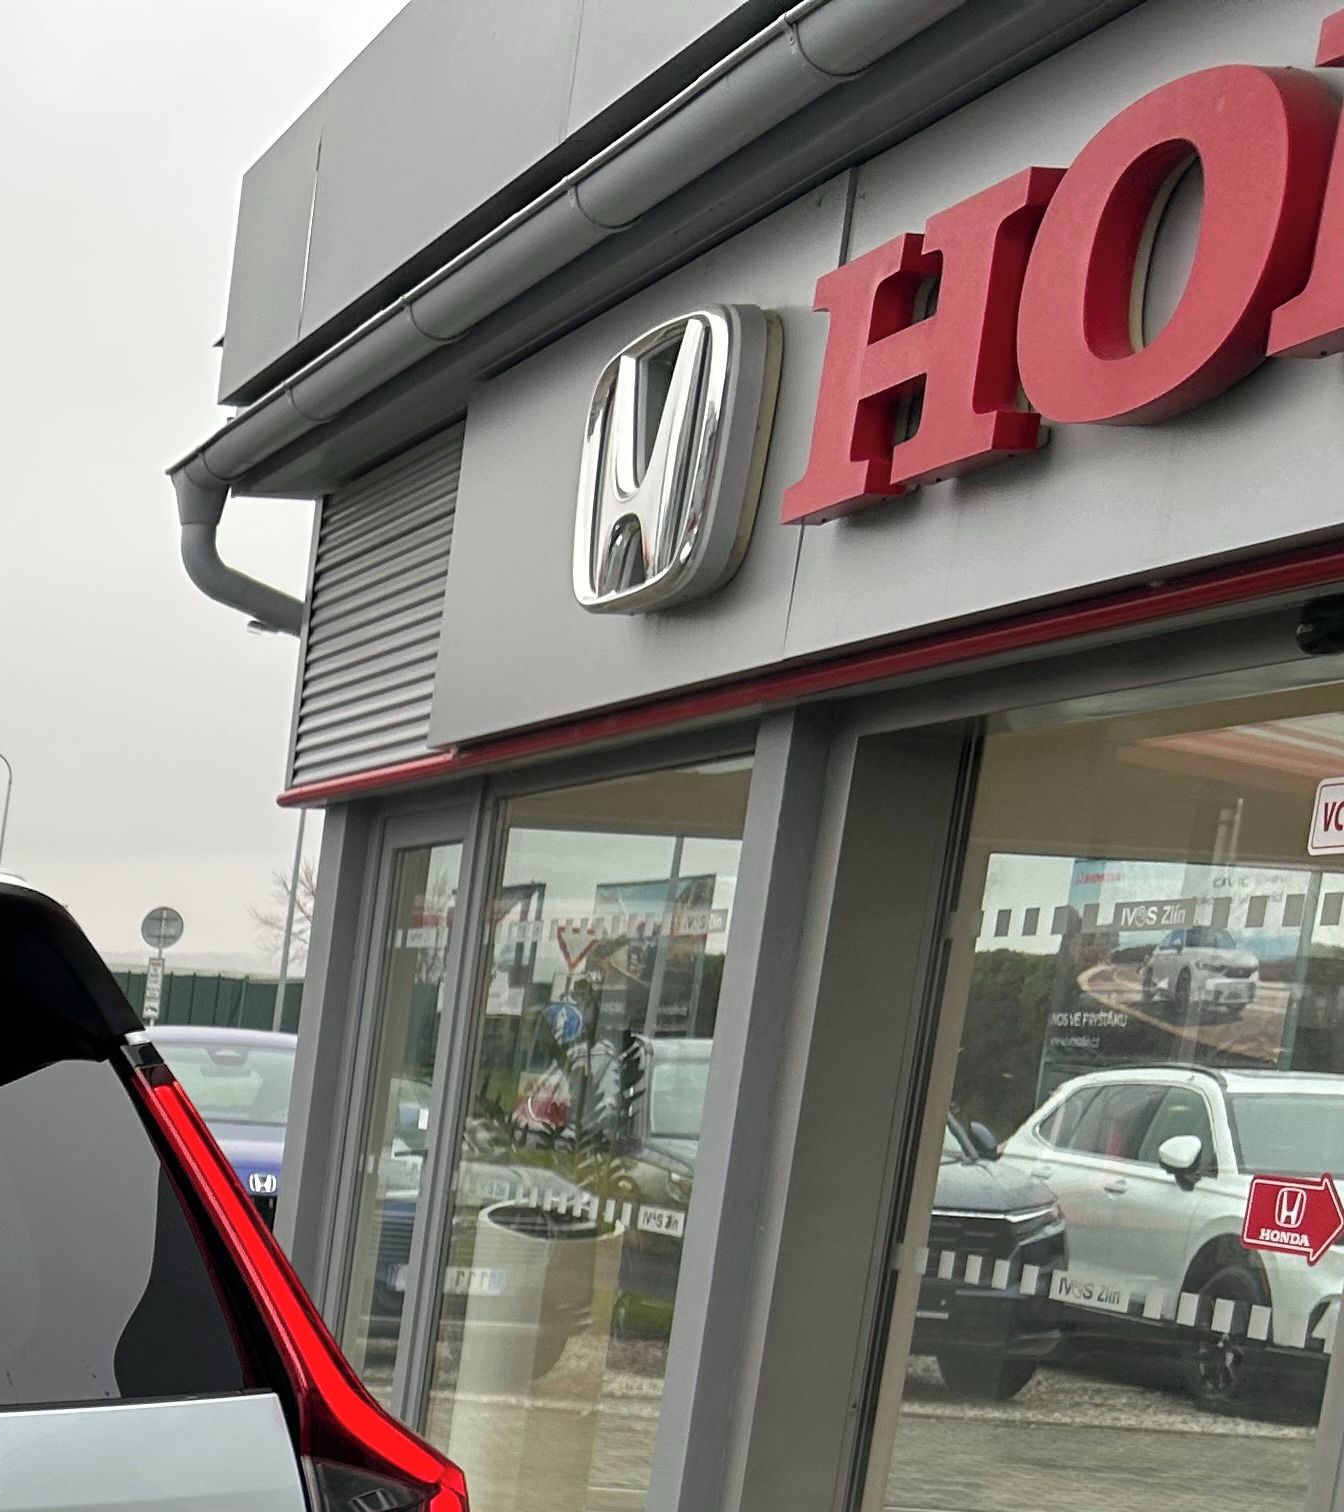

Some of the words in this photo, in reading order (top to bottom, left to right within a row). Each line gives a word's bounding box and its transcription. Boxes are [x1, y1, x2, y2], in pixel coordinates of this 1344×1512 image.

[782, 9, 1344, 525] HO
[1161, 904, 1186, 926] Zlín
[1259, 1228, 1310, 1247] HONDA
